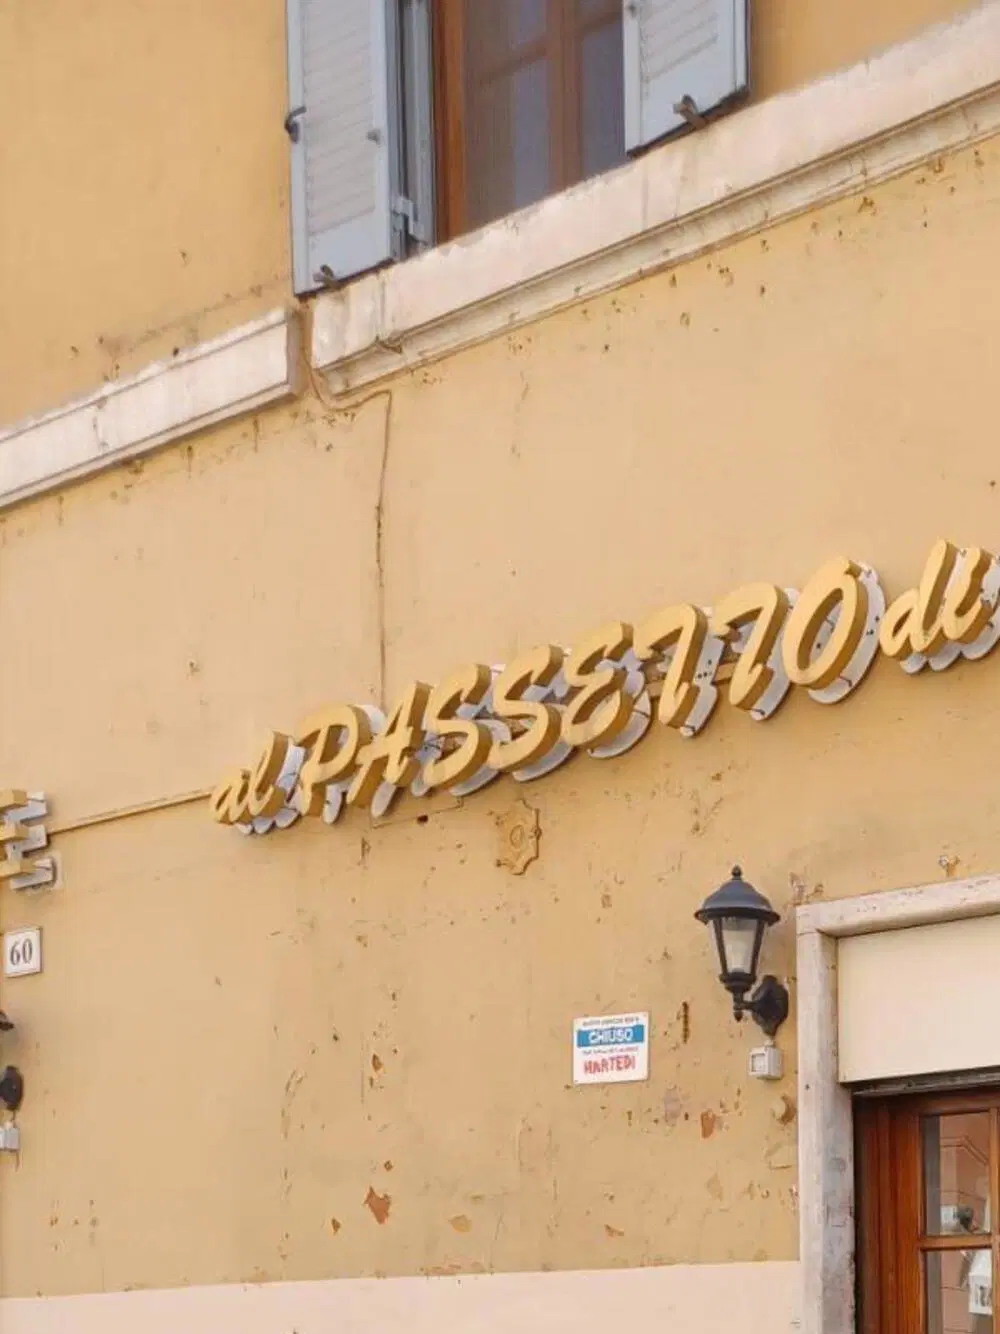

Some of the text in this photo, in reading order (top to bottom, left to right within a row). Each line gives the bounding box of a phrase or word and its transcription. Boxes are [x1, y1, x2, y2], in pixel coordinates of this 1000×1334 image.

[209, 730, 298, 832] al
[296, 557, 880, 828] PASSETTO
[9, 937, 34, 966] 60
[588, 1028, 634, 1044] CHIUSO
